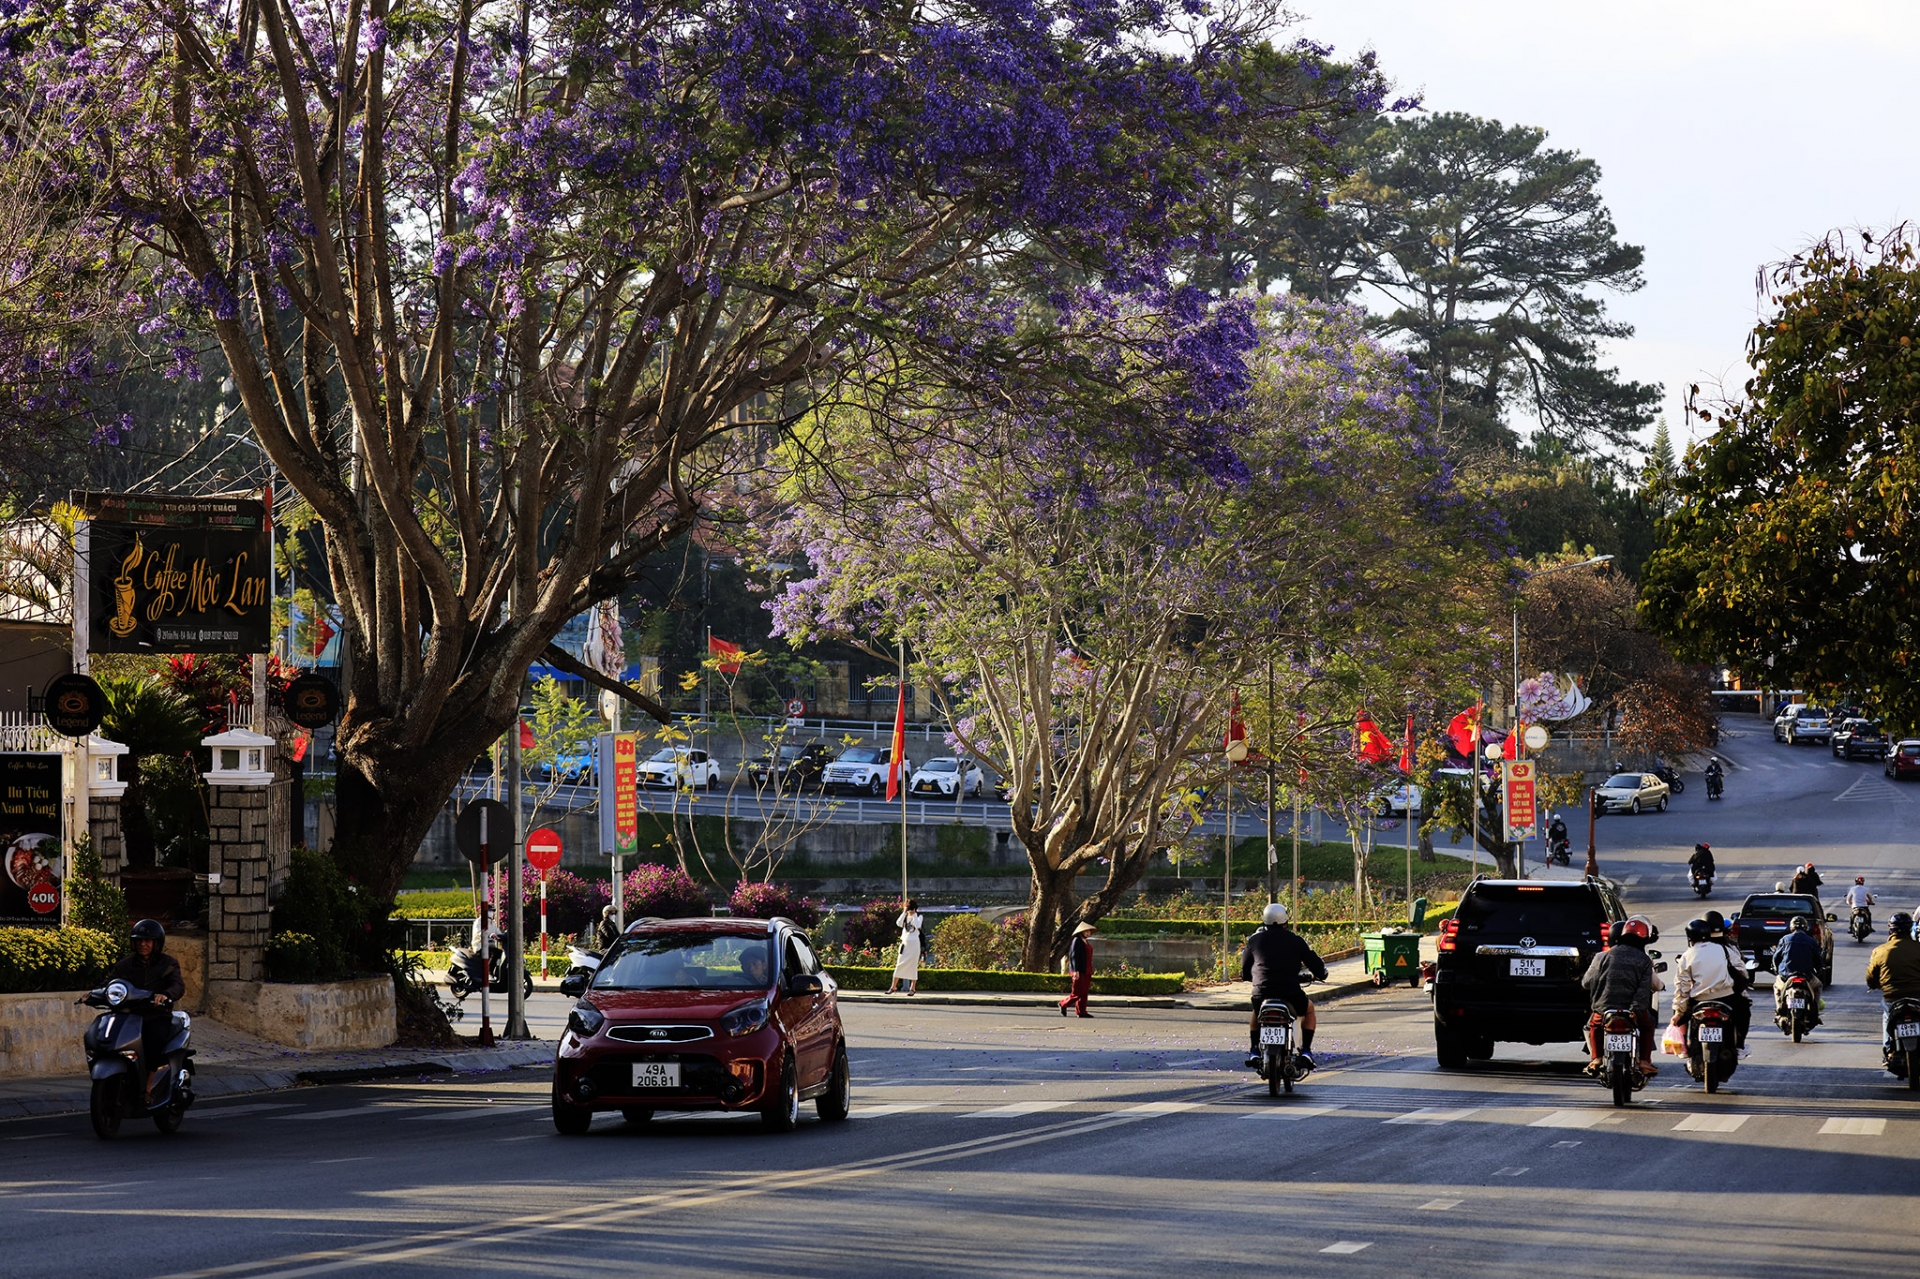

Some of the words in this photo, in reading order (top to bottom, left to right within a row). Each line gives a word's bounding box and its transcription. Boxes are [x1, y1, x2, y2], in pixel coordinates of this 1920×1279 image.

[143, 542, 187, 622] Coffee
[177, 557, 220, 617] Mộc
[224, 550, 267, 616] Lan
[295, 711, 328, 722] Legend
[56, 716, 90, 729] Legend
[1, 801, 25, 815] Nam
[28, 802, 57, 819] Vang
[31, 893, 55, 904] 40K
[645, 1064, 666, 1075] 49A
[637, 1076, 674, 1087] 206.81
